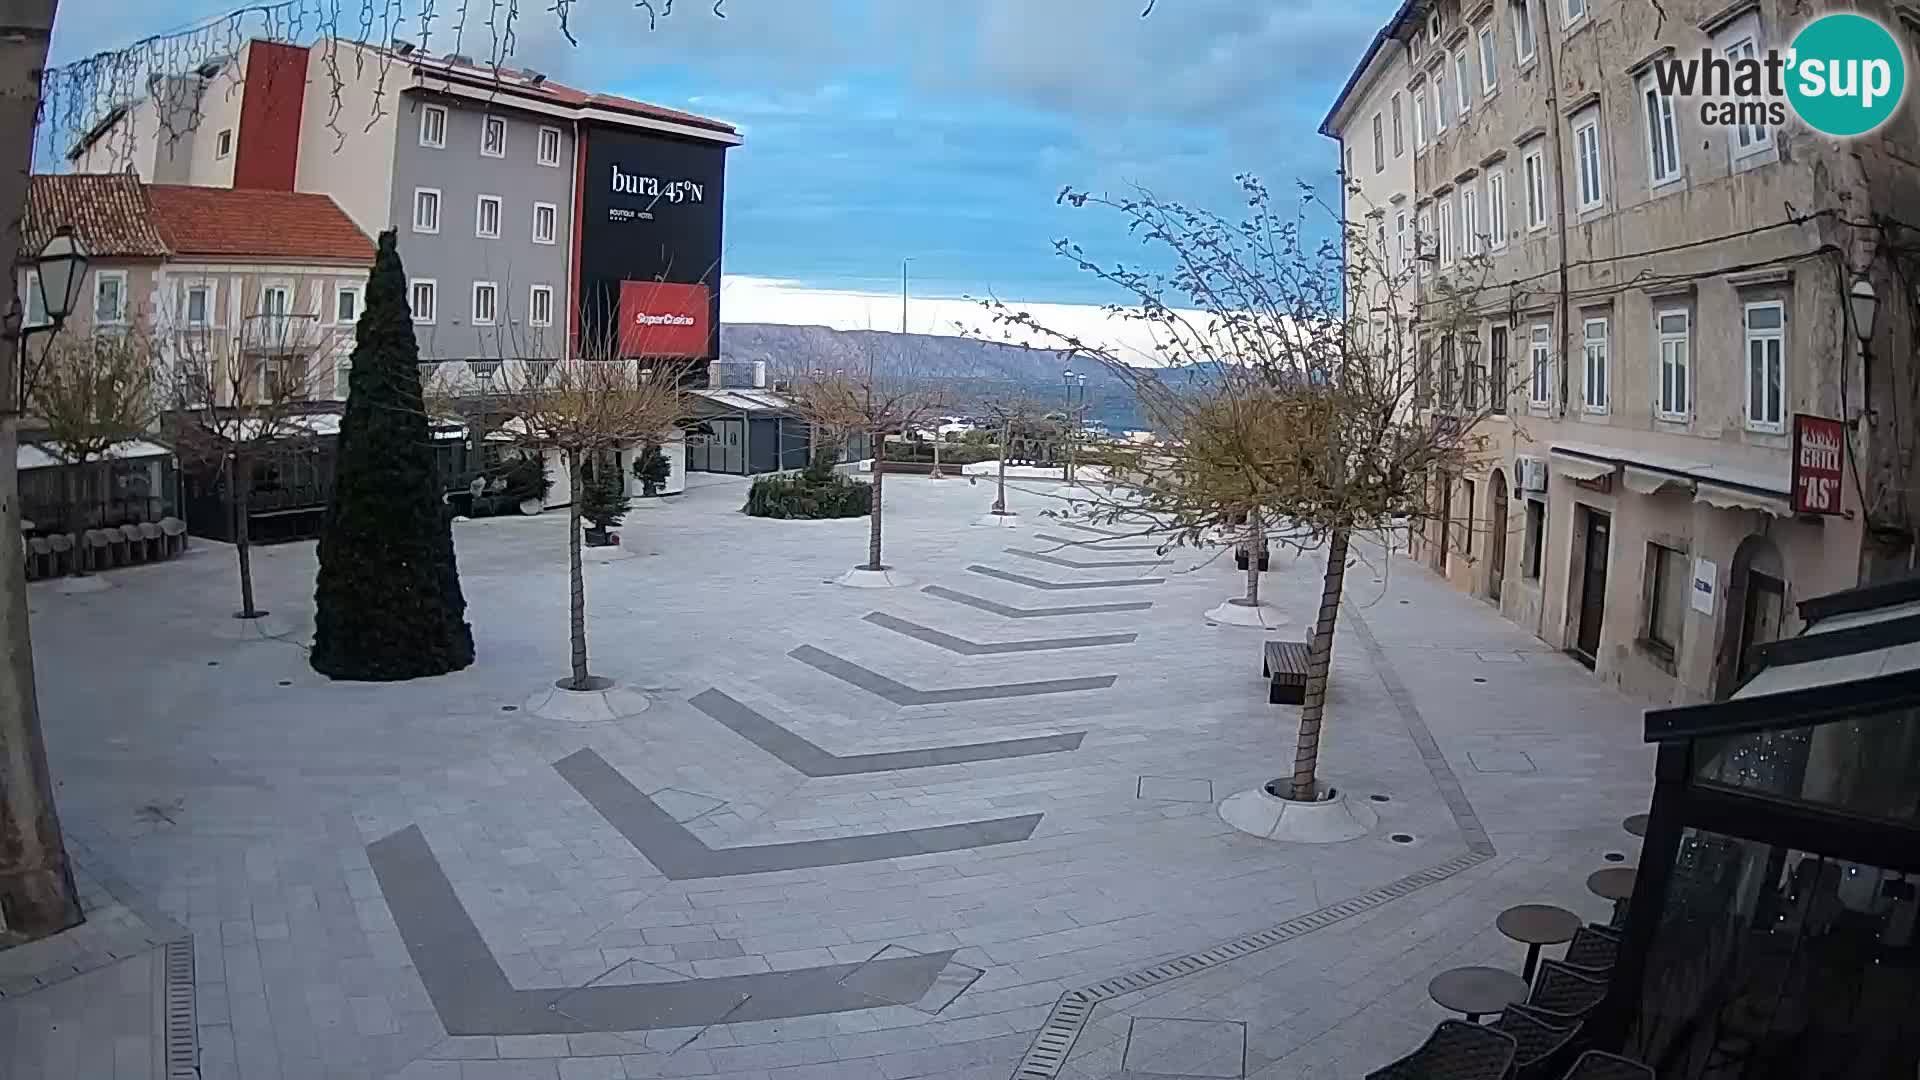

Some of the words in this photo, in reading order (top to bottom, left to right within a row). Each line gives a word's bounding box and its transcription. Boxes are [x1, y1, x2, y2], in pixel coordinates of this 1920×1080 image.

[612, 165, 658, 196] bura
[609, 208, 635, 218] BOUTIQUE
[637, 211, 654, 220] HOTEL
[1800, 447, 1840, 471] GRILL
